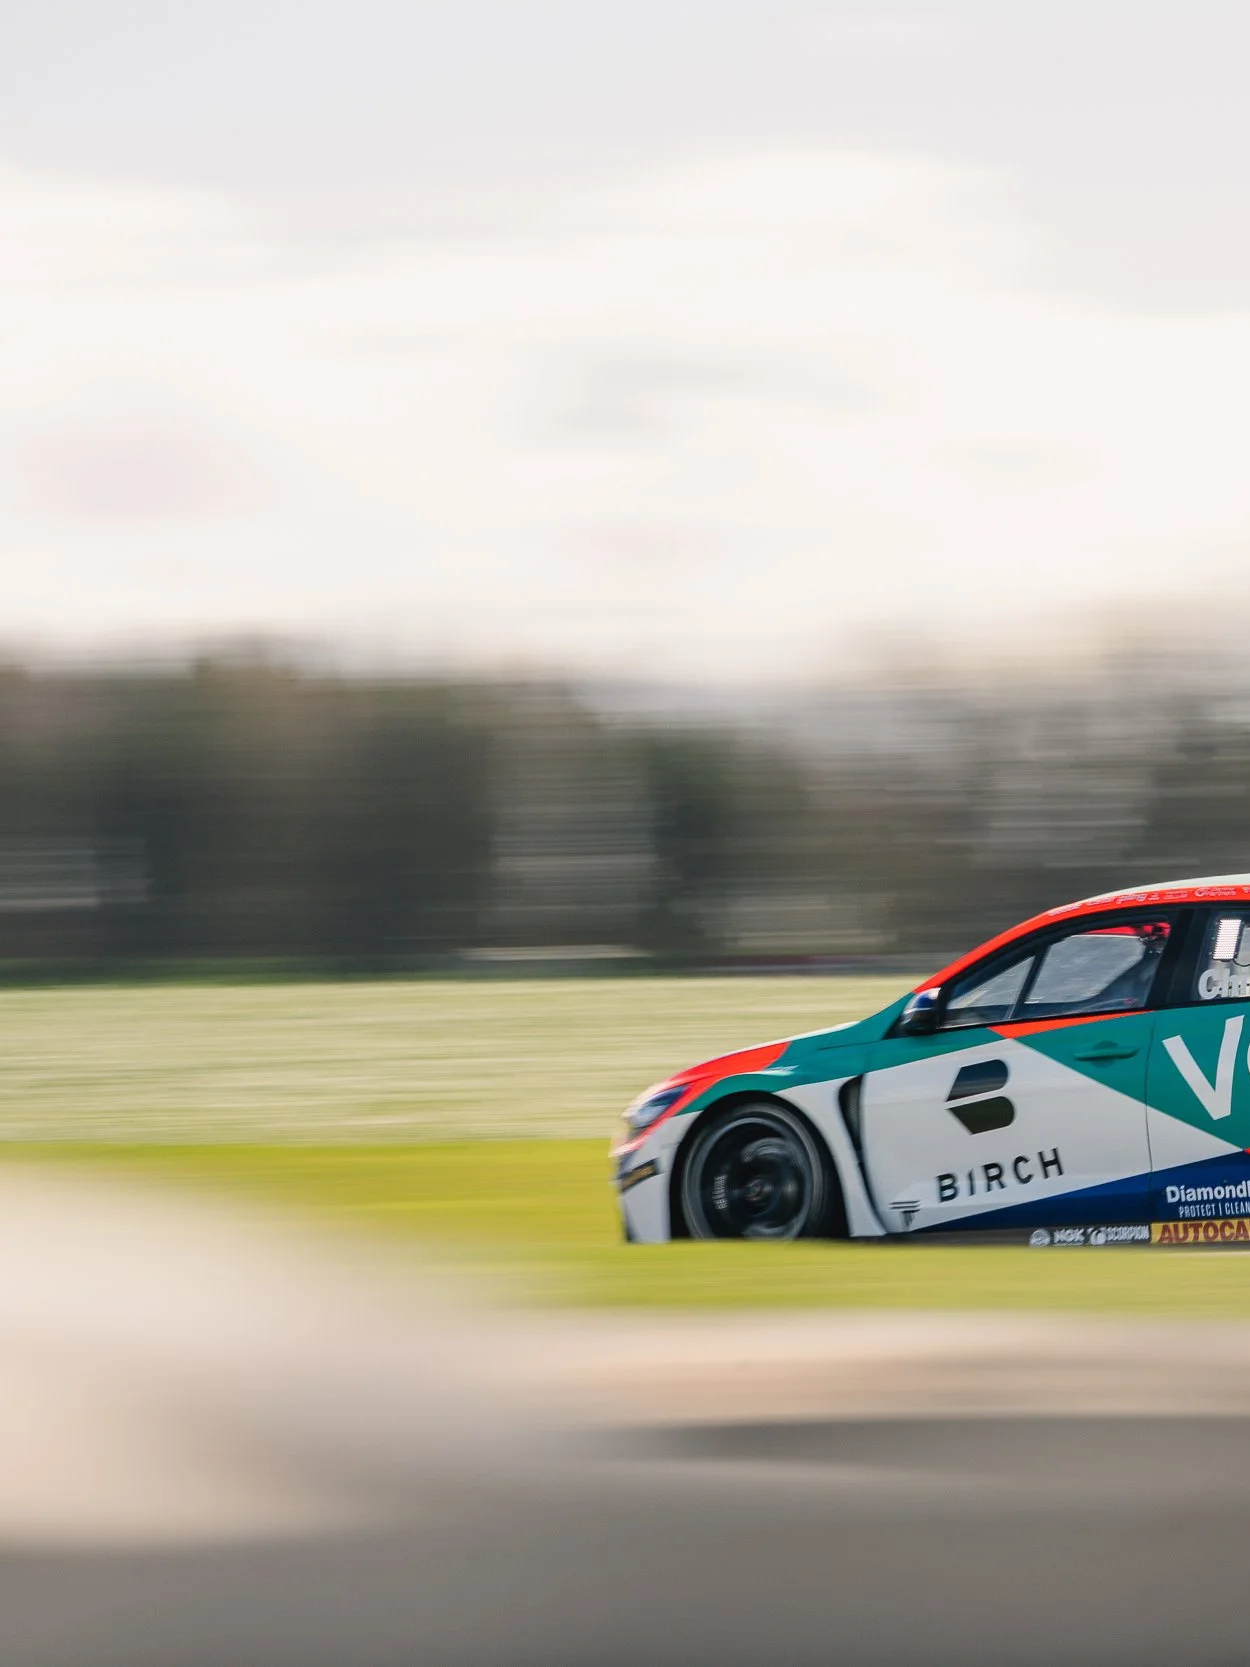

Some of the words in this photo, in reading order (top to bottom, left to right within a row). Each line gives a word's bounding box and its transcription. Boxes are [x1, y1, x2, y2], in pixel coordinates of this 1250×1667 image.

[936, 1147, 1064, 1203] BIRCH
[1178, 1203, 1217, 1218] PROTECT
[1225, 1201, 1250, 1216] CLEAN
